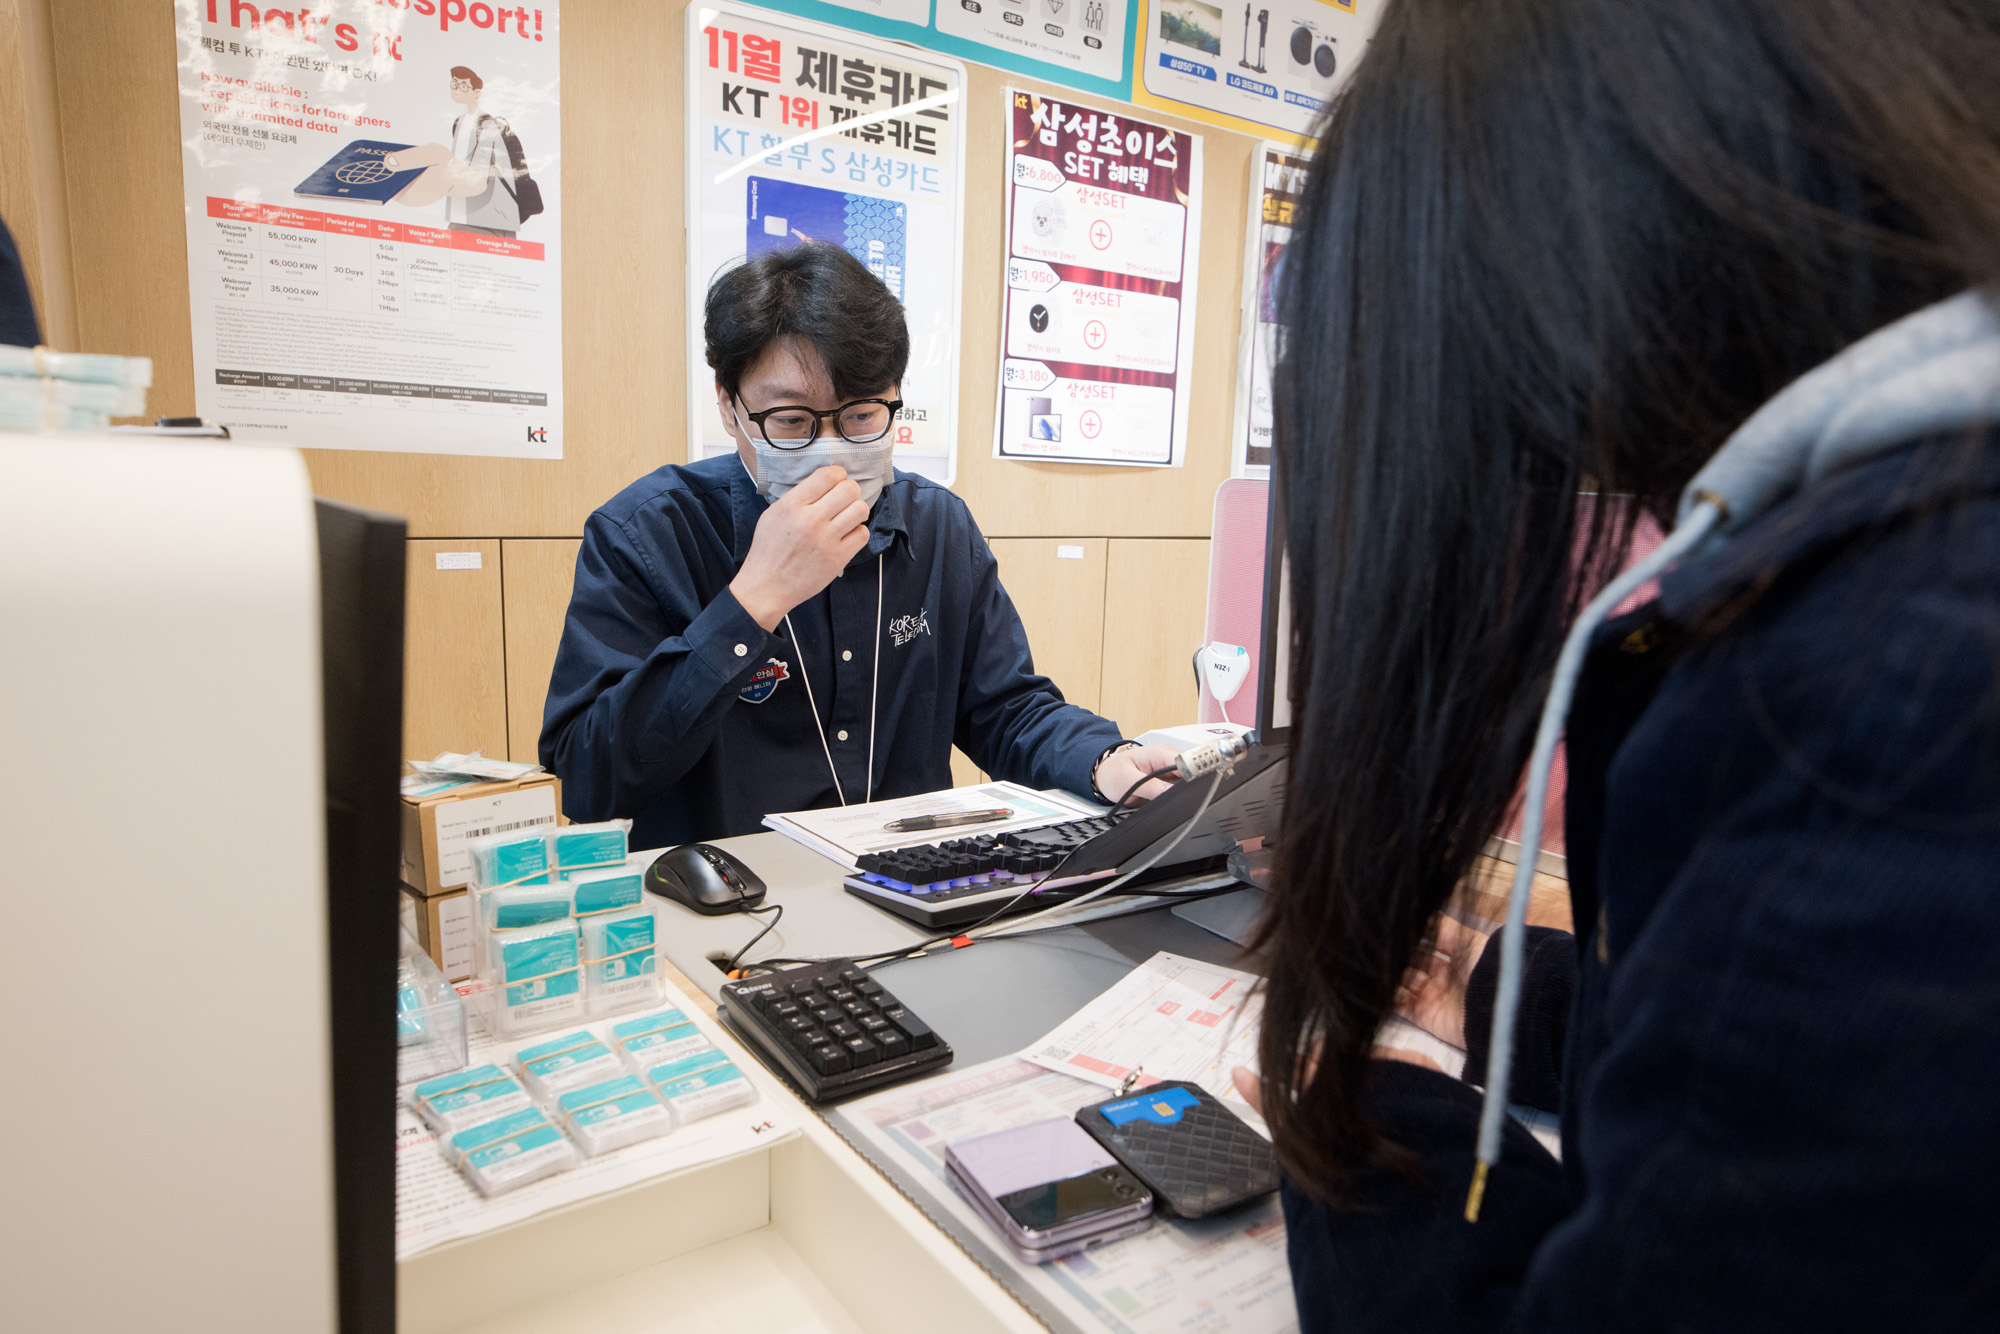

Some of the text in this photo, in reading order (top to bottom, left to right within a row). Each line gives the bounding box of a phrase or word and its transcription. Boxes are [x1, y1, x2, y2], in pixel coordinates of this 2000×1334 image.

[703, 25, 781, 85] 11월
[795, 45, 949, 122] 제휴카드
[1197, 66, 1207, 76] TV
[1231, 76, 1240, 86] LG
[1265, 86, 1274, 96] A9
[1013, 94, 1028, 110] kt
[302, 104, 321, 116] for
[722, 82, 937, 155] KT 1위 제휴카드
[203, 121, 230, 134] 외국인
[306, 120, 338, 134] data
[1029, 102, 1179, 168] 삼성초이스
[354, 147, 389, 156] PASS
[713, 125, 750, 157] KT
[821, 148, 837, 174] S
[844, 151, 941, 194] 삼성카드
[1065, 151, 1149, 192] SET 혜택
[1076, 187, 1127, 209] 삼성SET
[216, 222, 246, 232] Welcome
[326, 217, 346, 227] Period
[222, 230, 247, 239] Prepaid
[378, 224, 395, 233] Data
[409, 229, 426, 237] Voice
[268, 232, 317, 244] 55,000 KRW
[503, 242, 521, 250] Rates
[217, 249, 248, 259] Welcome
[223, 257, 248, 266] Prepaid
[269, 259, 318, 271] 45,000 KRW
[334, 266, 364, 277] 30 Days
[221, 277, 252, 286] Welcome
[224, 284, 249, 293] Prepaid
[270, 285, 319, 297] 35,000 KRW
[1072, 288, 1124, 308] 삼성SET
[1067, 382, 1117, 399] 삼성SET
[527, 426, 548, 443] kt
[895, 426, 914, 444] 요
